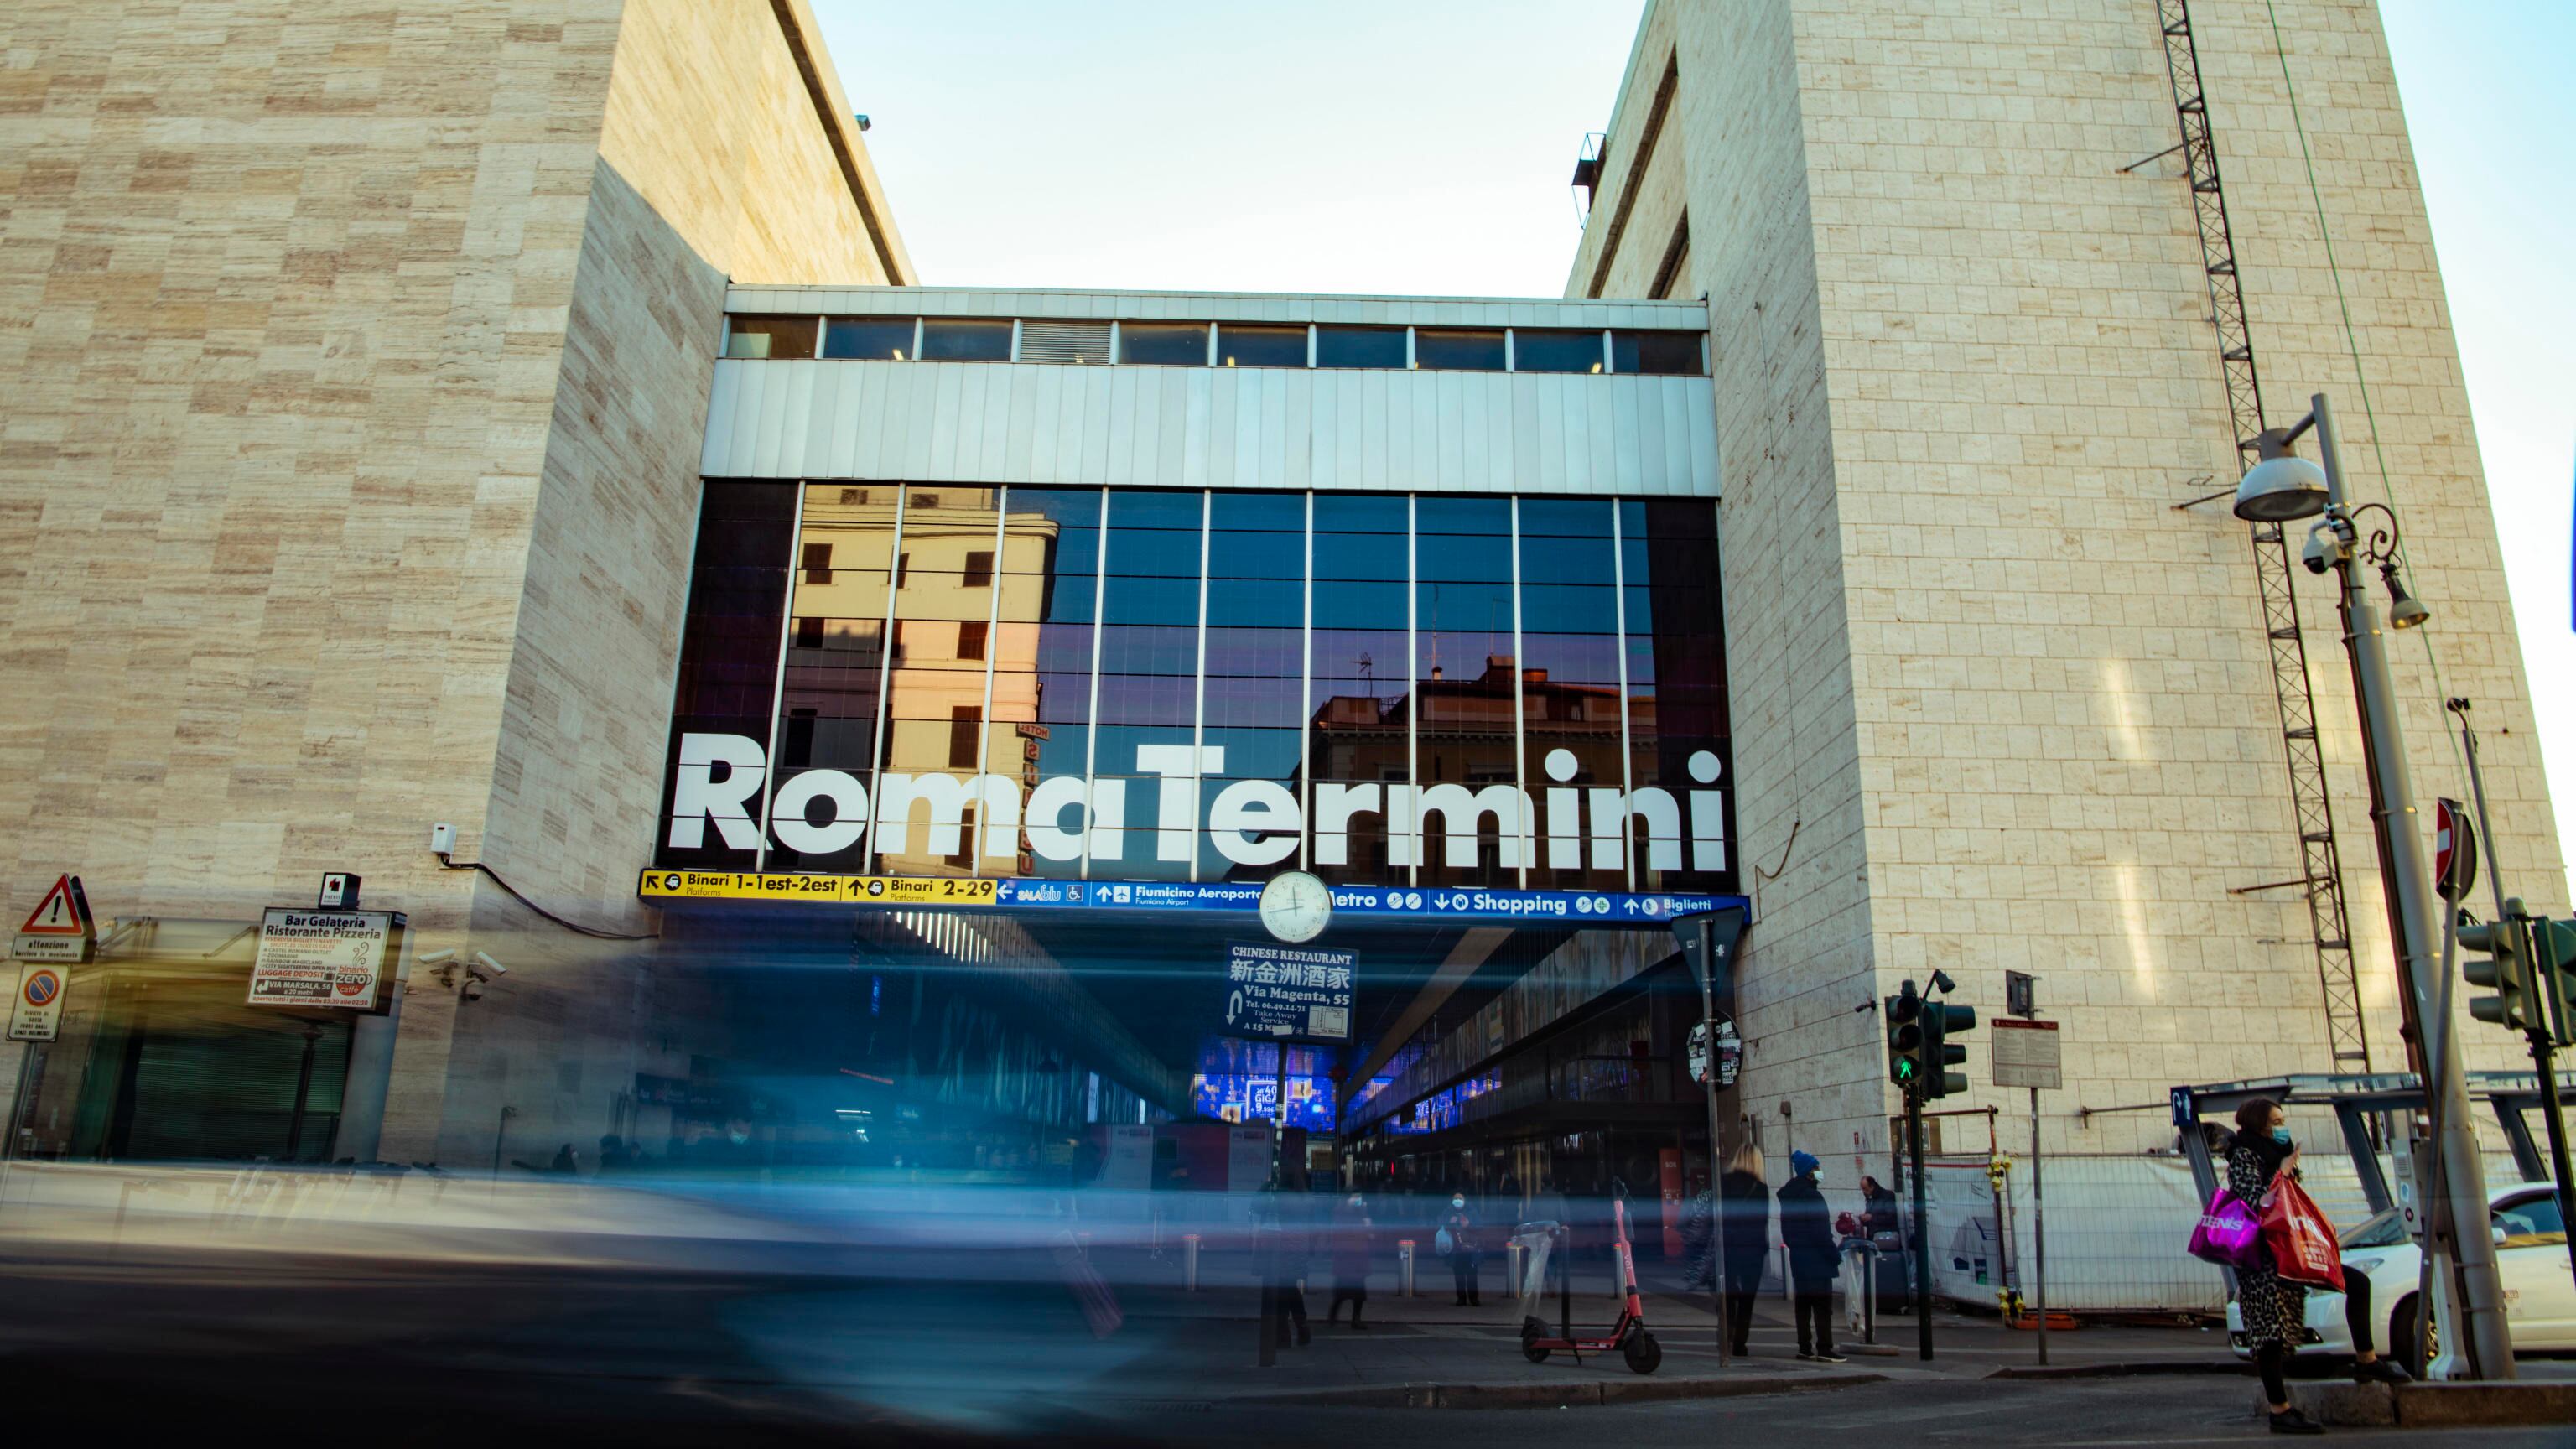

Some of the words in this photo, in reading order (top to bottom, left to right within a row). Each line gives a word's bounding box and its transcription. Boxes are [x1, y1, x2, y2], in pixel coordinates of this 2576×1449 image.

[688, 874, 730, 886] Binari
[736, 874, 838, 892] 1-1est-2est
[891, 879, 933, 892] Binari
[943, 880, 993, 896] 2-29
[686, 887, 721, 896] Platforms
[890, 893, 926, 902] Platforms
[1135, 886, 1196, 898] Fiumicino
[1135, 898, 1165, 906] Fiumicino
[1166, 899, 1189, 907] Airport
[1473, 894, 1567, 915] Shopping
[1663, 898, 1711, 913] Biglietti
[285, 915, 307, 927] Bar
[309, 916, 366, 929] Gelateria
[266, 925, 330, 937] Ristorante
[332, 927, 382, 940] Pizzeria
[28, 939, 69, 949] attenzione
[1232, 946, 1278, 959] CHINESE
[1280, 950, 1353, 964] RESTAURANT
[339, 965, 369, 974] binario
[1230, 958, 1351, 989] 新金洲酒家
[283, 981, 320, 990] MARSALA,
[1244, 984, 1266, 998] Via
[1270, 987, 1331, 1005] Magenta,
[1333, 994, 1351, 1005] 55
[1254, 1009, 1273, 1018] Take
[1275, 1011, 1297, 1020] Away
[1260, 1016, 1290, 1026] Service
